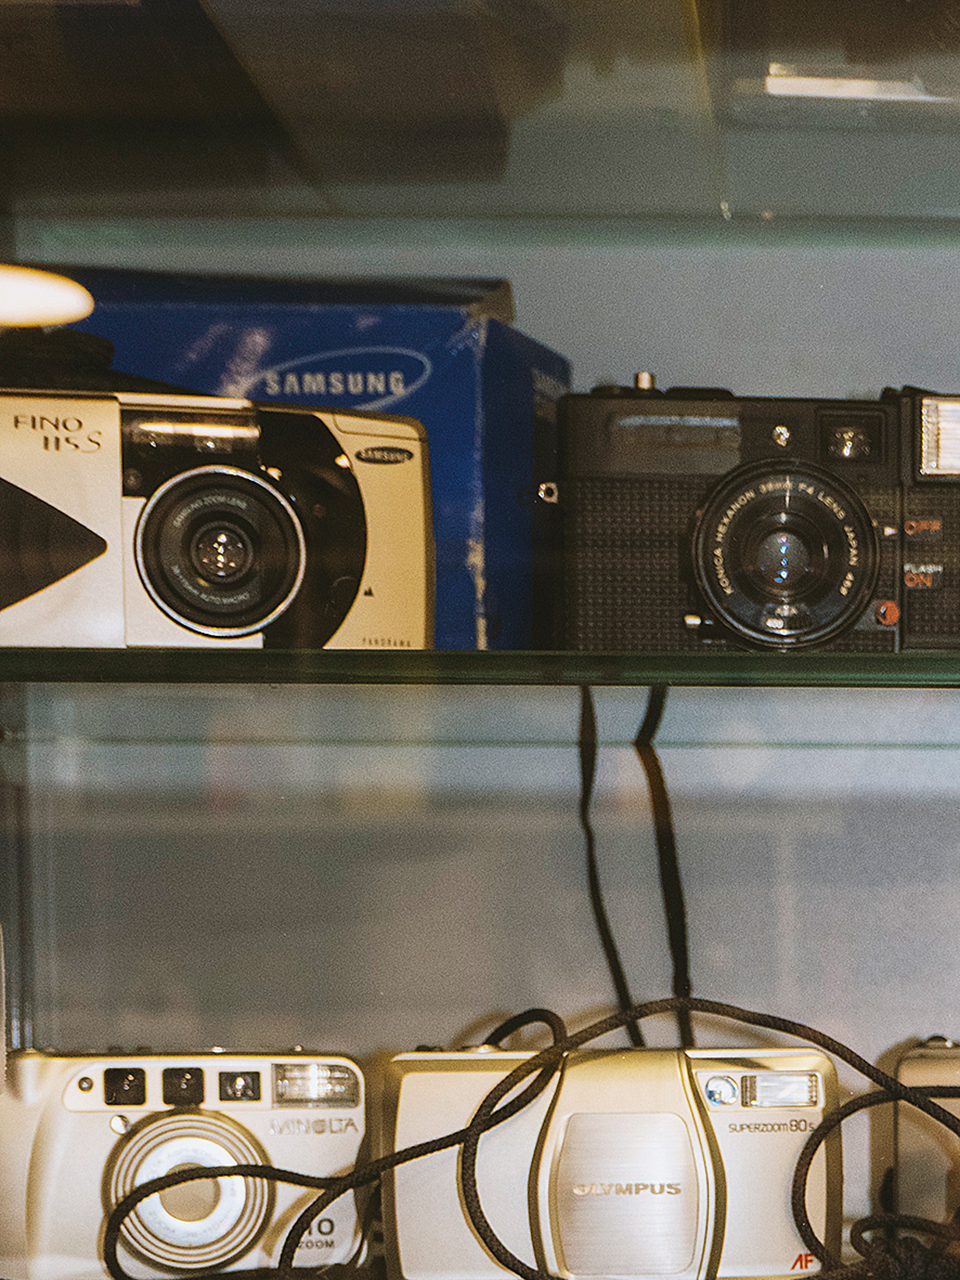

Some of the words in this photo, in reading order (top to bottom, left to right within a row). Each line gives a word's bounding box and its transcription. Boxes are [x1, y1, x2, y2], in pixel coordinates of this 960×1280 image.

[264, 369, 406, 396] SAMSUNG
[13, 414, 84, 432] FINO
[360, 449, 411, 464] SAMSUNG
[817, 490, 847, 521] LENS
[715, 489, 756, 543] HEXANON
[843, 524, 859, 566] JAPAN
[712, 547, 734, 595] KONICA
[903, 572, 933, 588] ON
[269, 1117, 359, 1135] MINOLTA
[572, 1182, 683, 1196] OLYMPUS
[790, 1253, 815, 1270] AF
